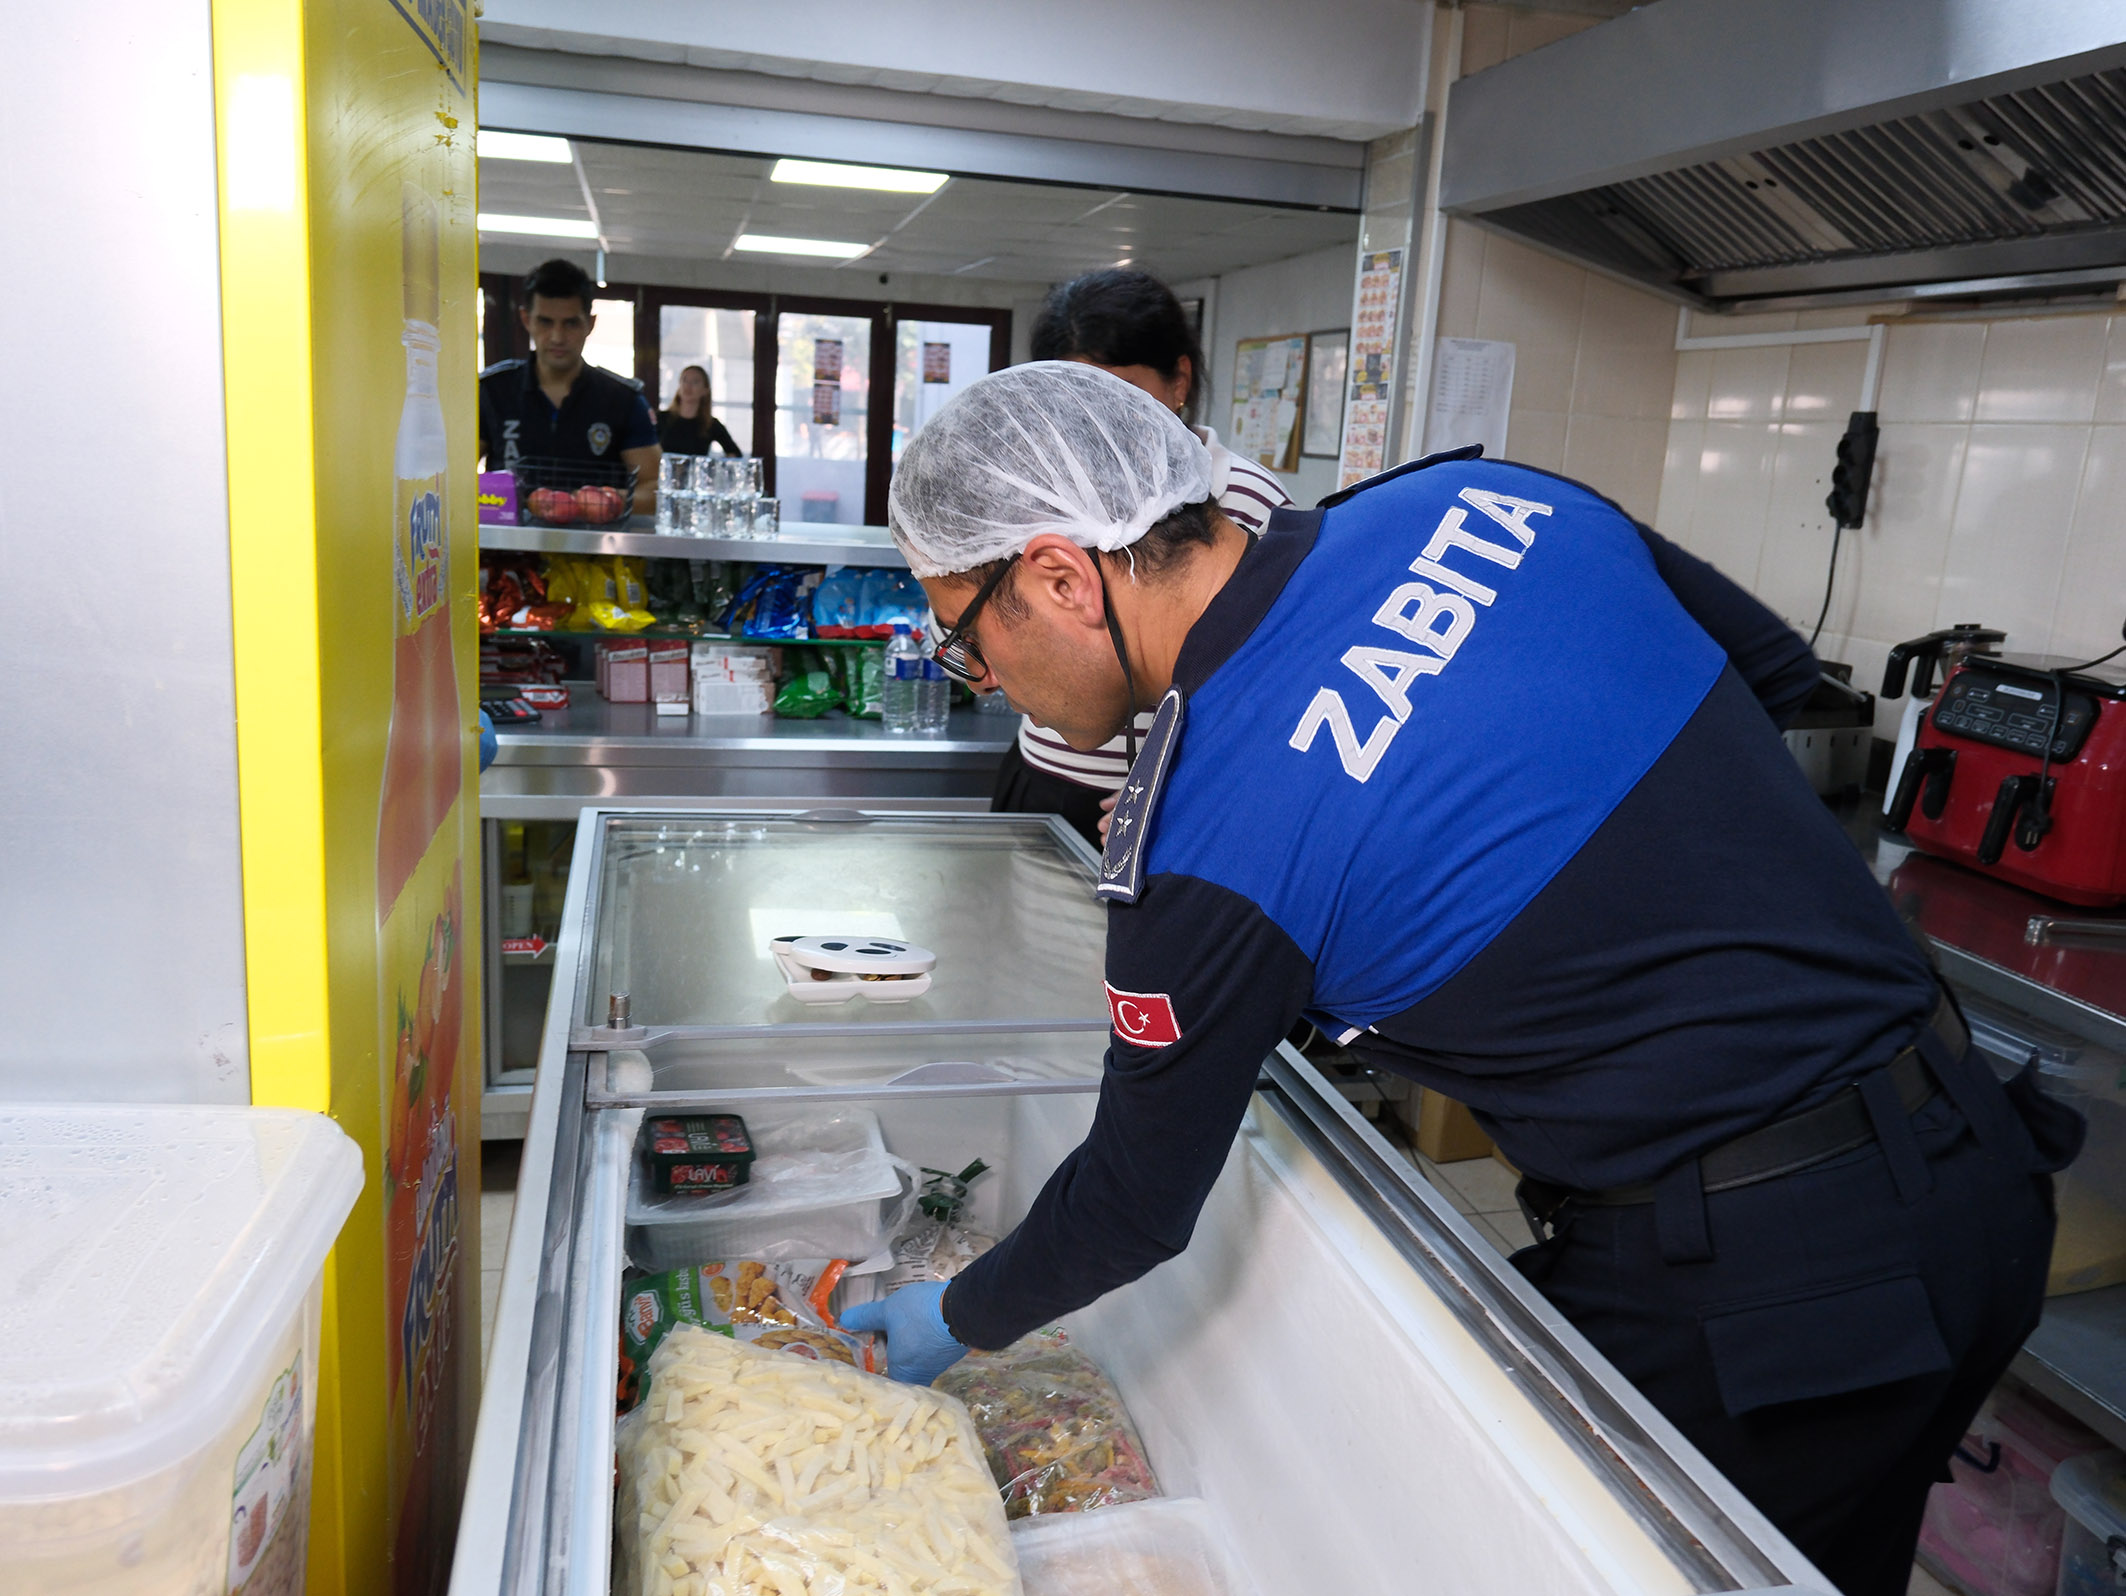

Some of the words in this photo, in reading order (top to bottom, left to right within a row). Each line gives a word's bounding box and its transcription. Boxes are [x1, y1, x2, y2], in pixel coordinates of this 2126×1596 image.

[1288, 486, 1554, 784] ZABITA
[502, 941, 534, 951] OPEN
[634, 1295, 655, 1339] Banvit
